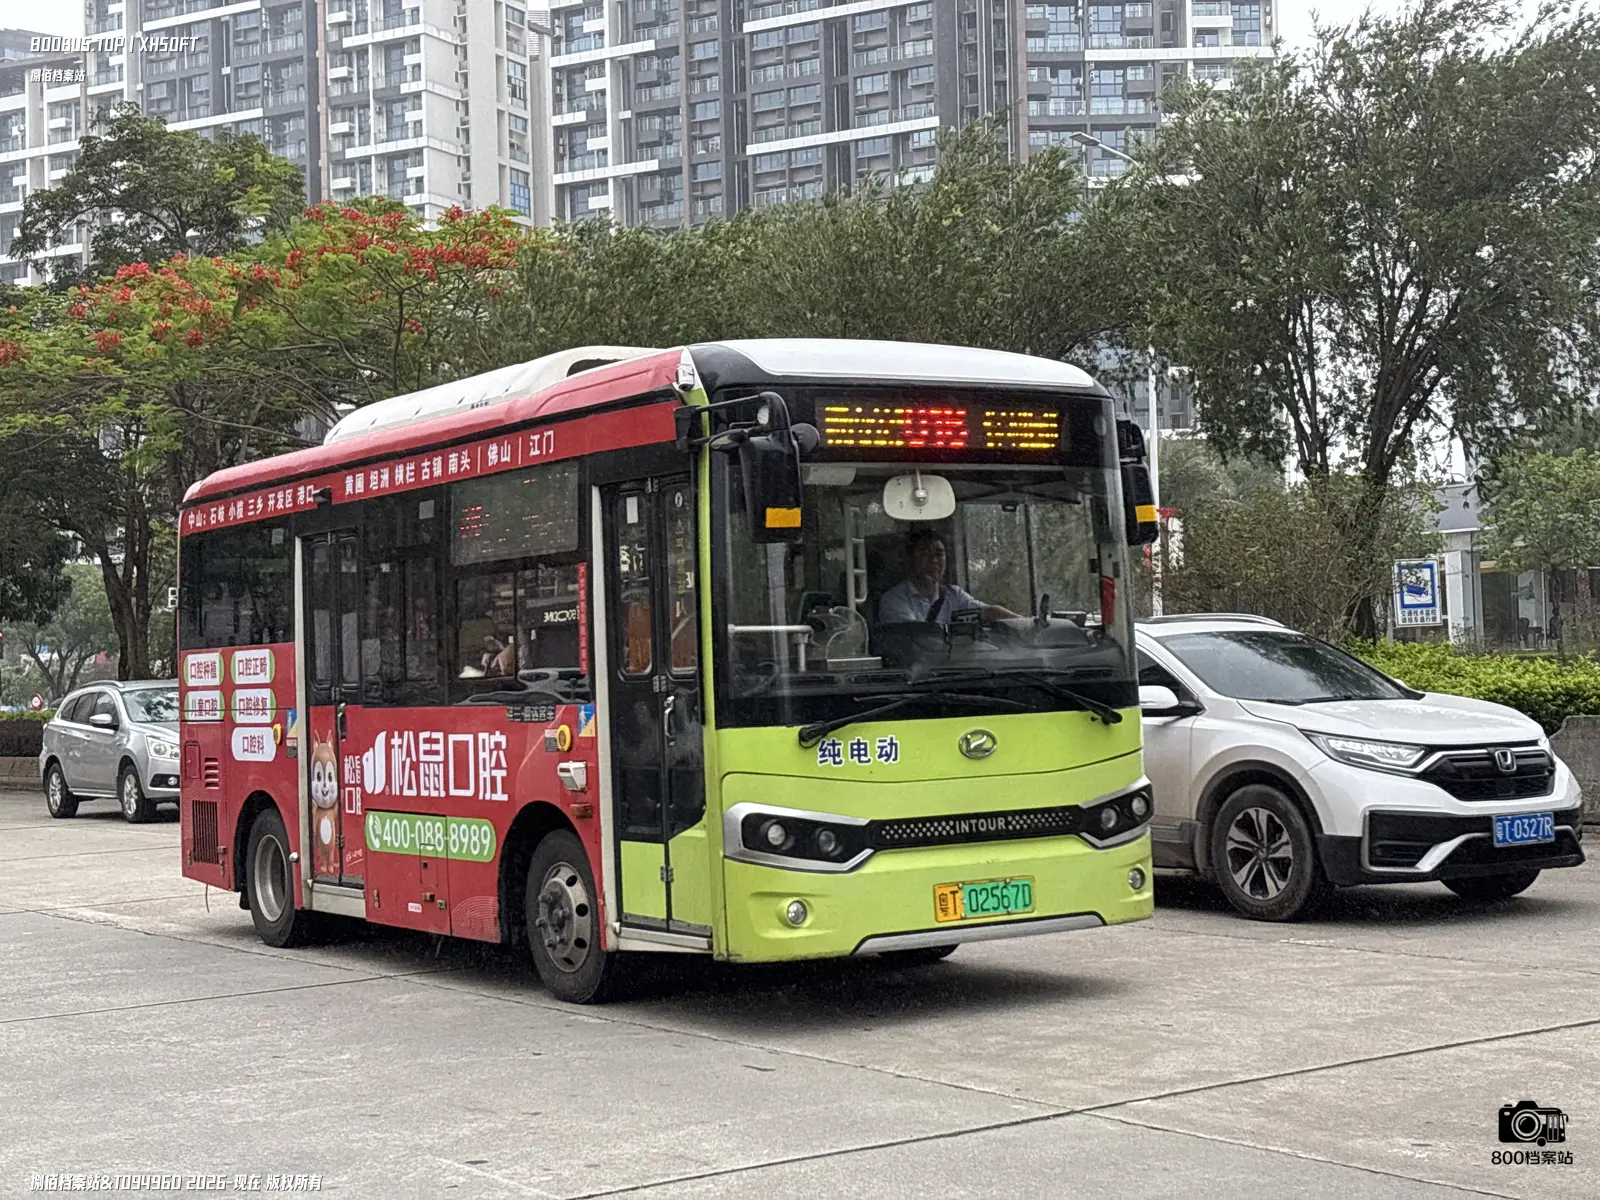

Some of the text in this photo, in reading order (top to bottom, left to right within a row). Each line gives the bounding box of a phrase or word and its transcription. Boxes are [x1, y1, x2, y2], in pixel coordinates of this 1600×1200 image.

[247, 496, 264, 516] 三乡
[267, 489, 293, 512] 开发区
[297, 484, 314, 505] 港口
[369, 468, 389, 491] 坦洲
[421, 456, 443, 480] 古镇
[448, 451, 471, 475] 南头
[487, 440, 511, 466] 佛山
[529, 430, 555, 456] 江门
[390, 730, 509, 801] 松鼠口腔
[818, 735, 900, 766] 纯电动
[382, 818, 491, 856] 400-088-8989
[955, 816, 1007, 834] INTOUR
